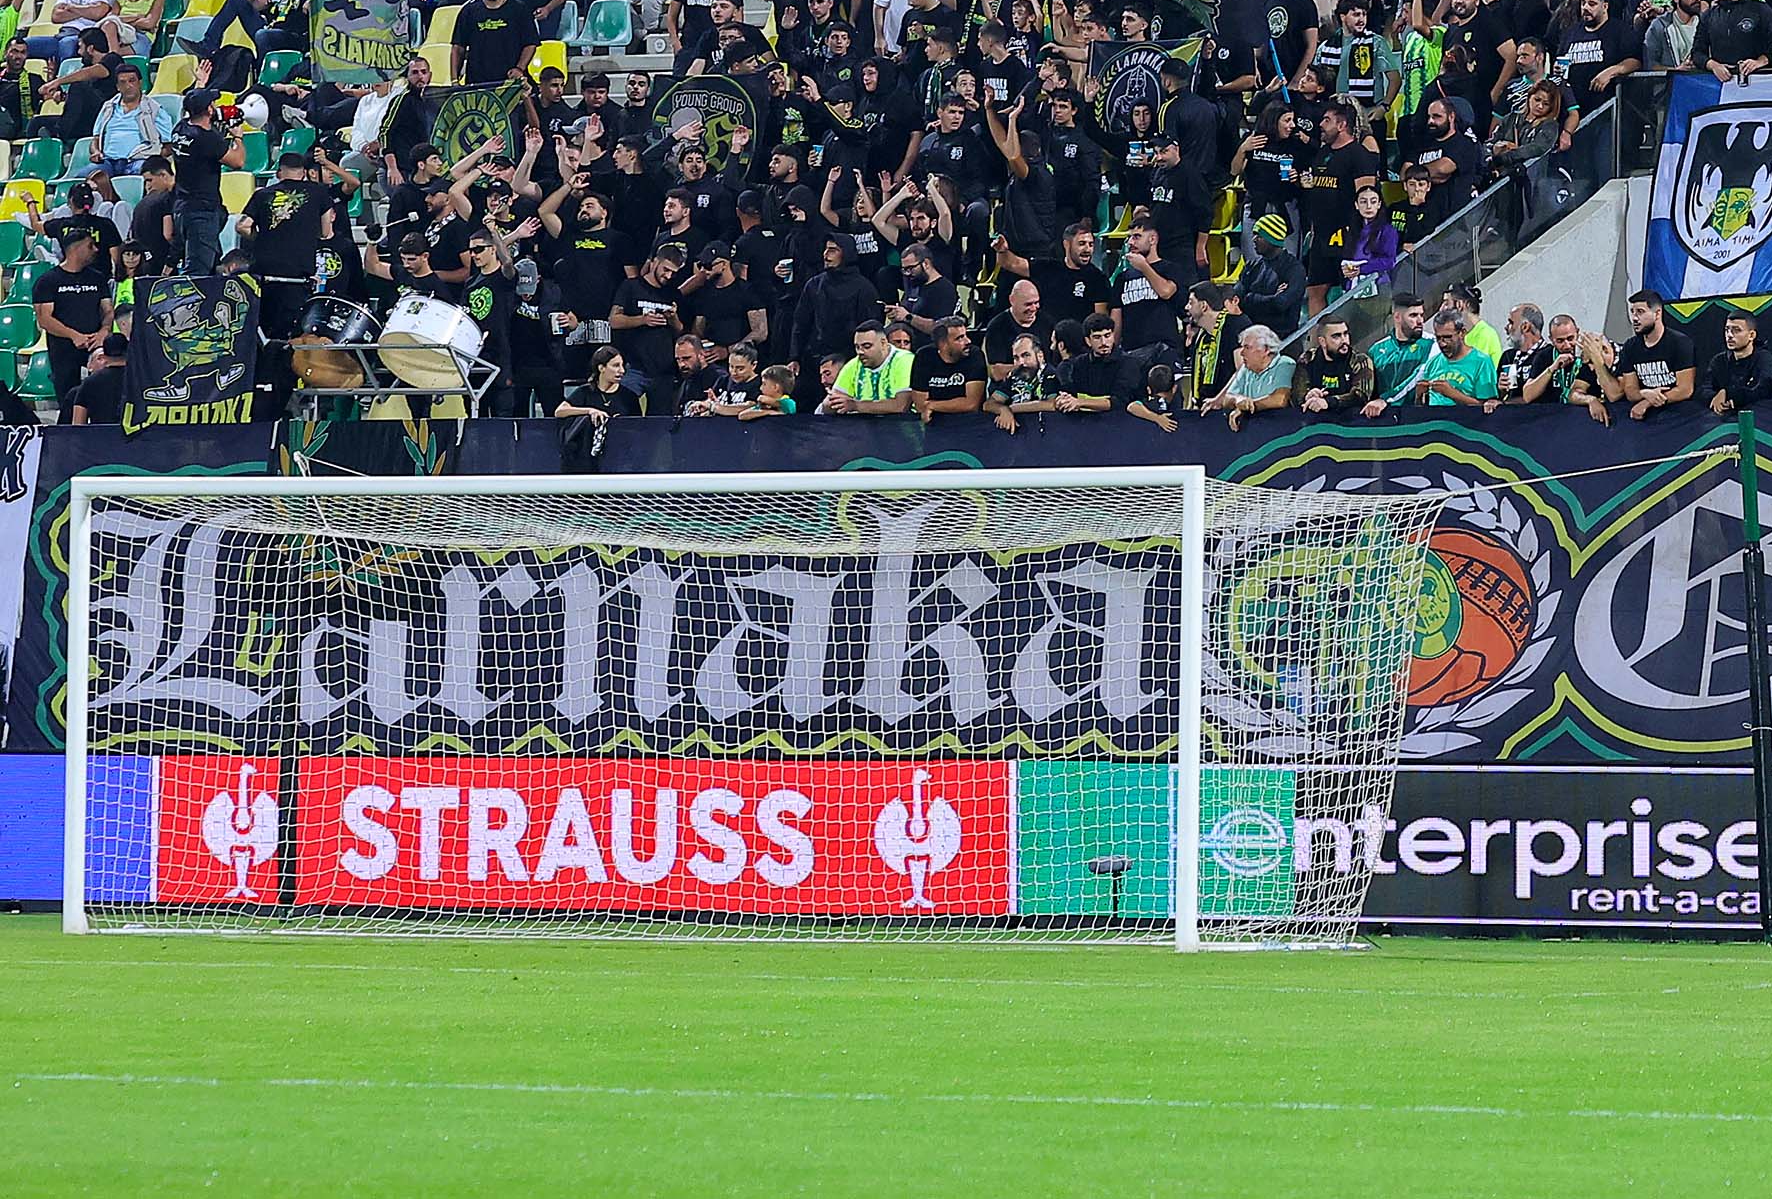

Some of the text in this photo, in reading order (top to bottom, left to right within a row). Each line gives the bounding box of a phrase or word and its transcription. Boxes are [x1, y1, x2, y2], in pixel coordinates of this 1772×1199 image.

[675, 93, 746, 116] YOUNG GROUP
[1712, 249, 1731, 260] 2001
[340, 784, 815, 888] STRAUSS
